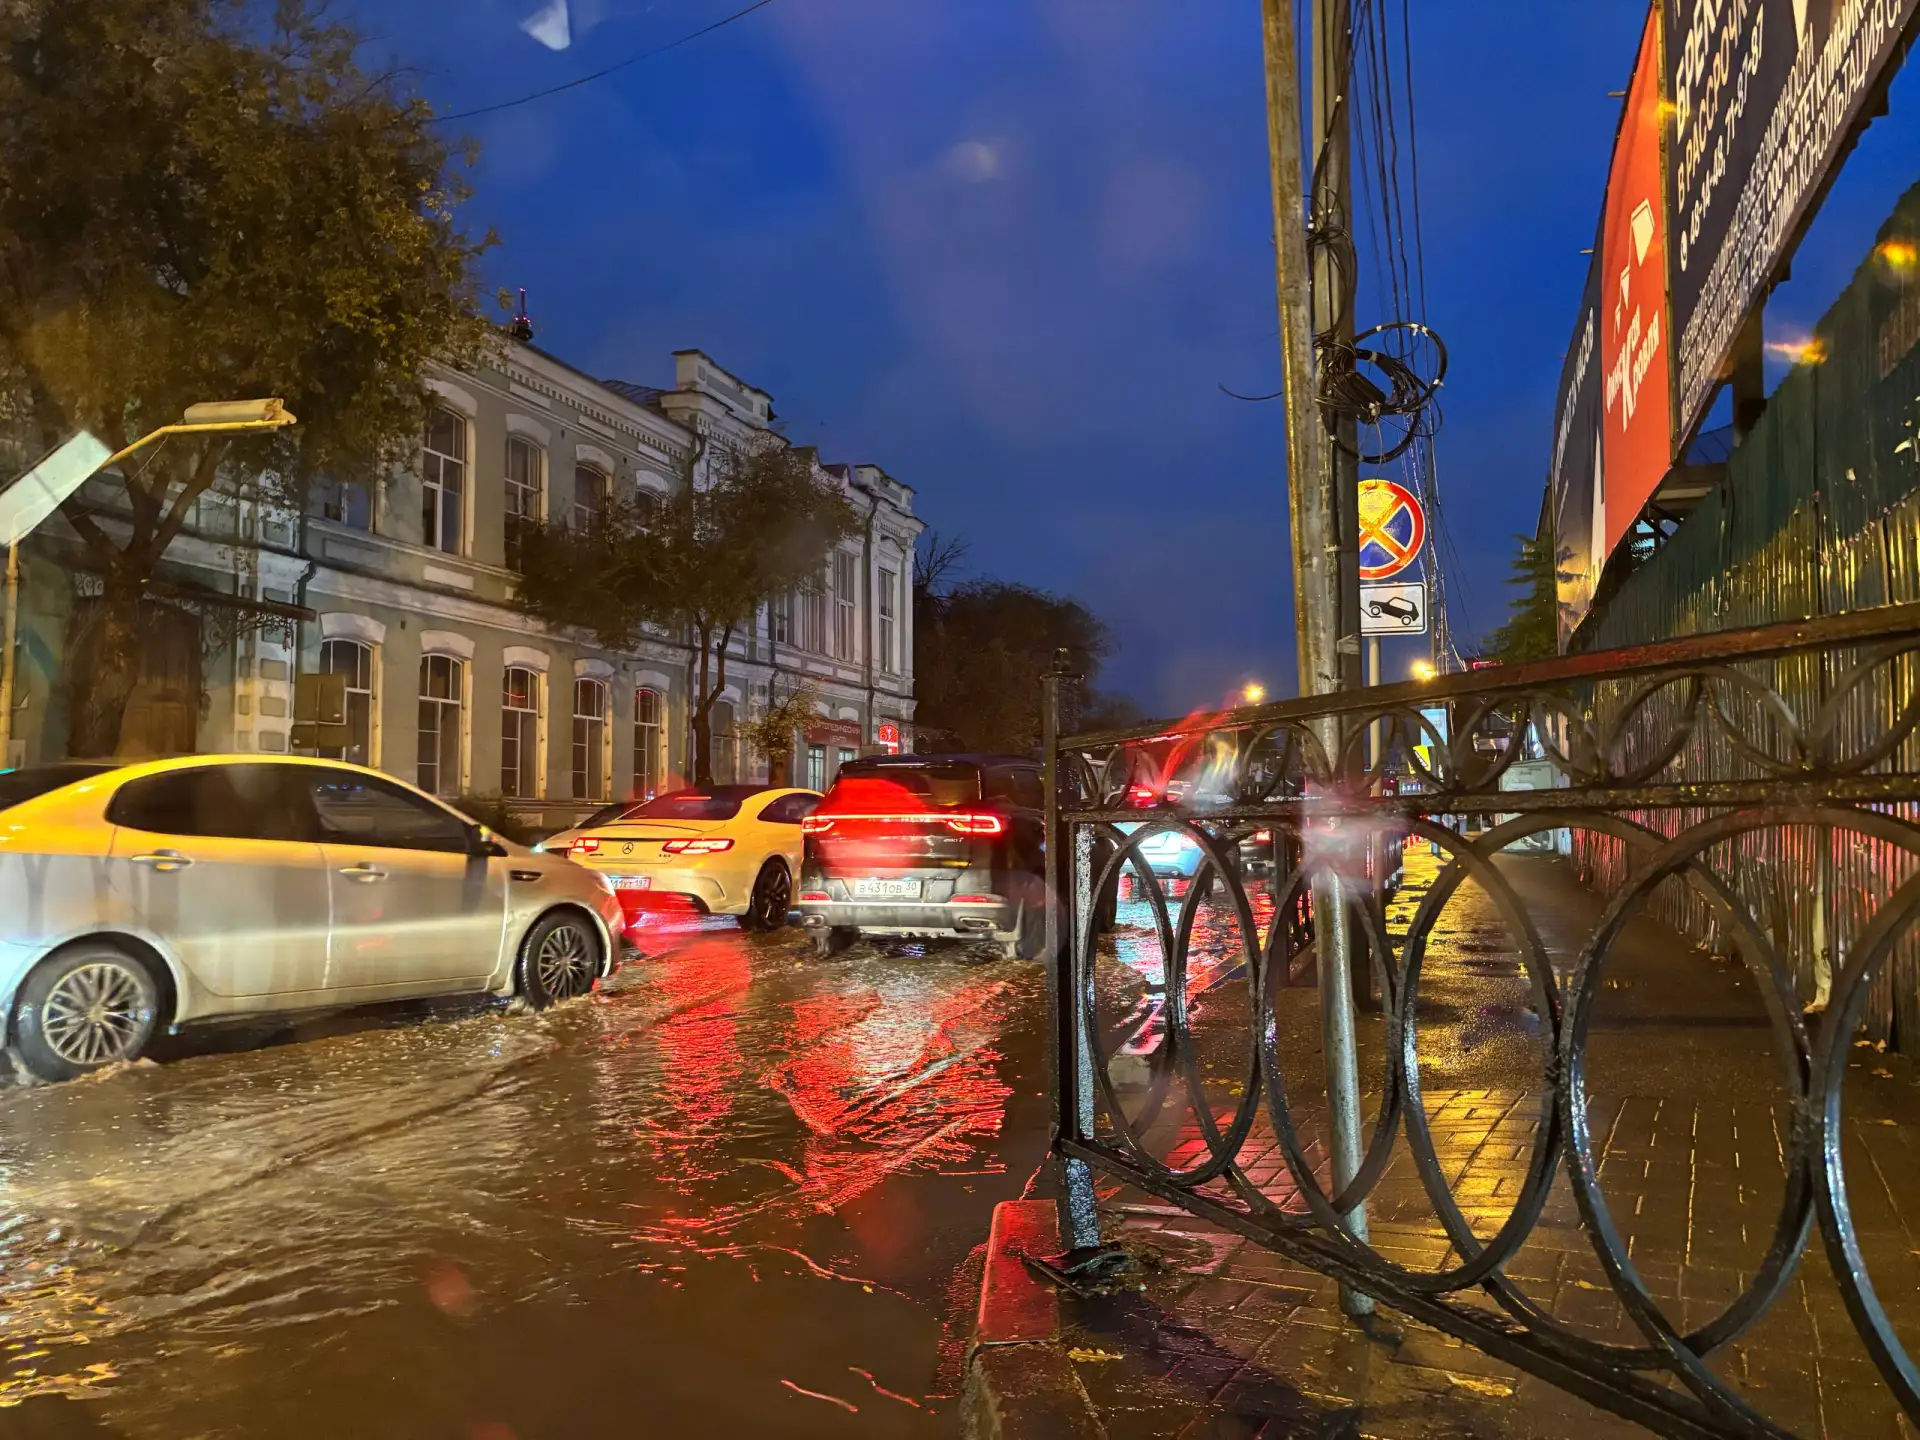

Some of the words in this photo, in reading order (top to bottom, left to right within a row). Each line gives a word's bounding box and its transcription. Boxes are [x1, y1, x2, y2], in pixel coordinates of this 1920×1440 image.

[1676, 0, 1723, 143] БРЕК
[1677, 162, 1685, 215] В
[1686, 0, 1750, 193] РАССРОЧК
[1749, 165, 1799, 291] НЕОБХОДИМА
[1799, 0, 1884, 197] КОНСУЛЬТАЦИЯ
[1756, 22, 1815, 192] ВОЗМОЖНОСТИ
[1767, 147, 1783, 212] ООО
[905, 881, 917, 891] 30
